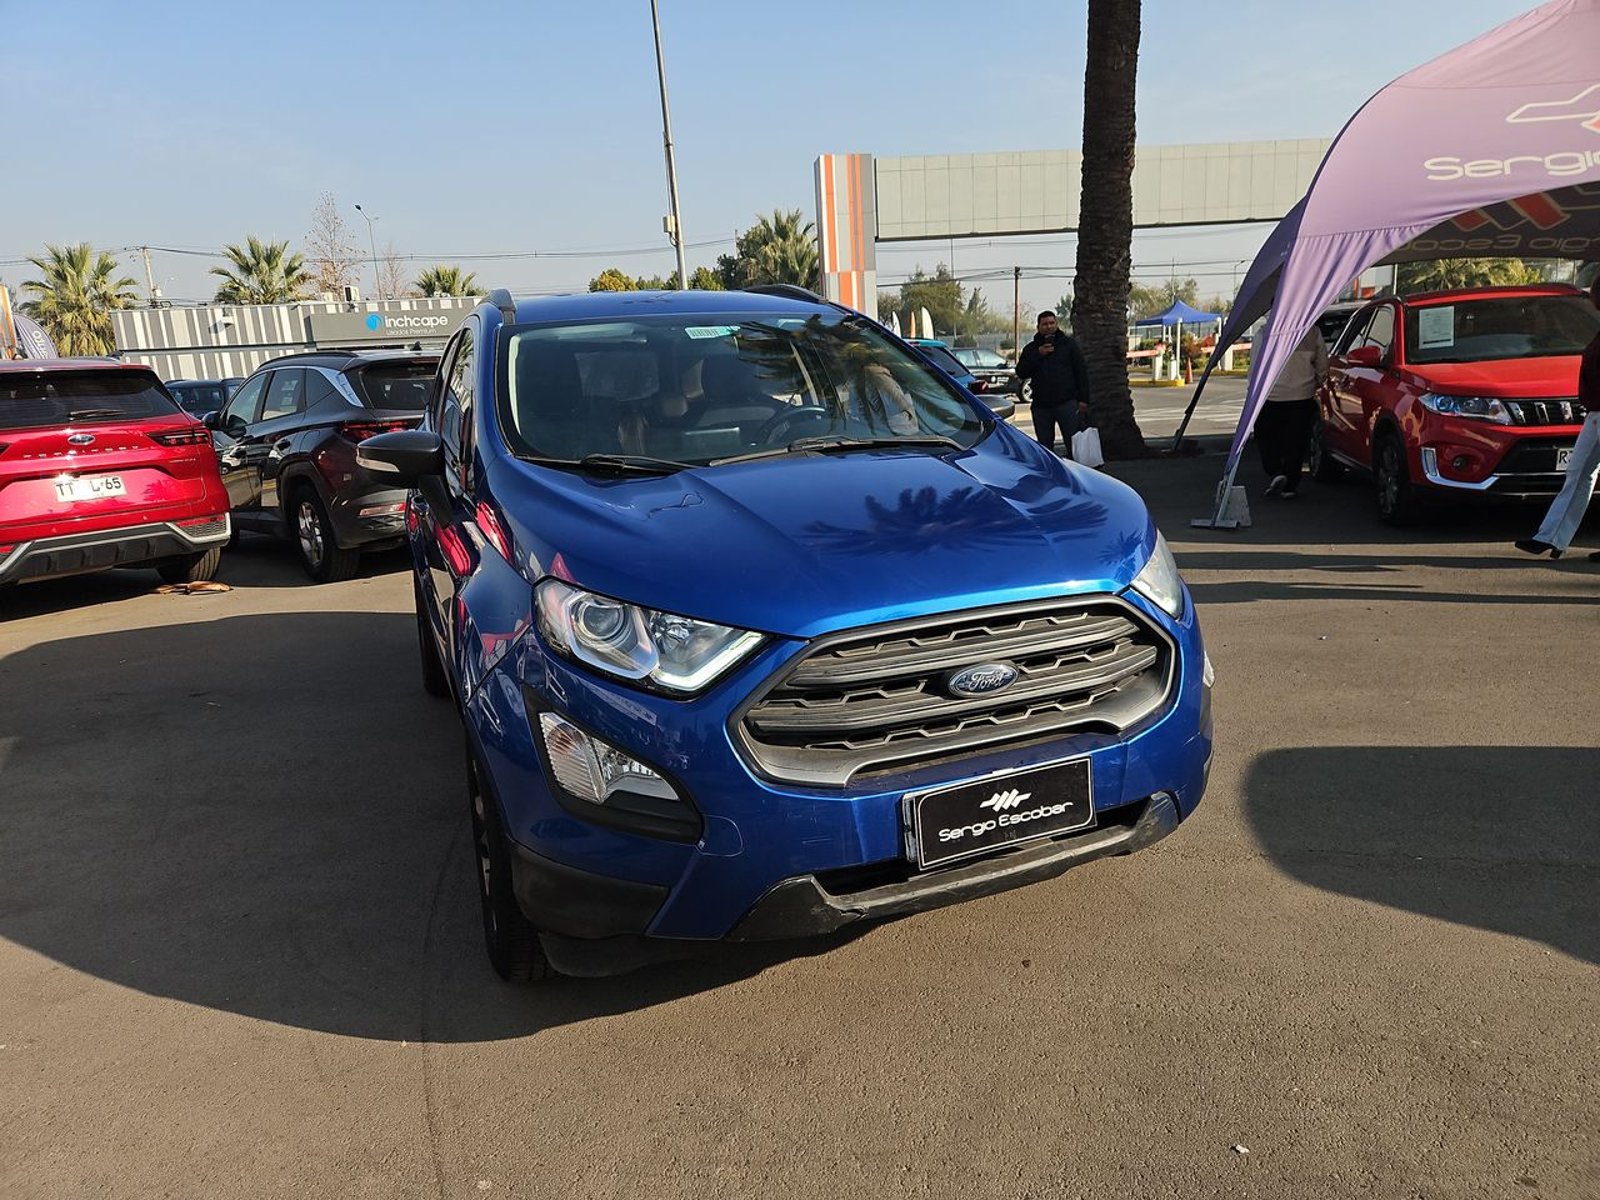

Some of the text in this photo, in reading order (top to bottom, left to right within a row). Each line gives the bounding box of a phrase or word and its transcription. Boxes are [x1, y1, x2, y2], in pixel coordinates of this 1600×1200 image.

[384, 315, 448, 328] inchcape
[968, 669, 1005, 691] Ford
[998, 801, 1074, 826] Escobar
